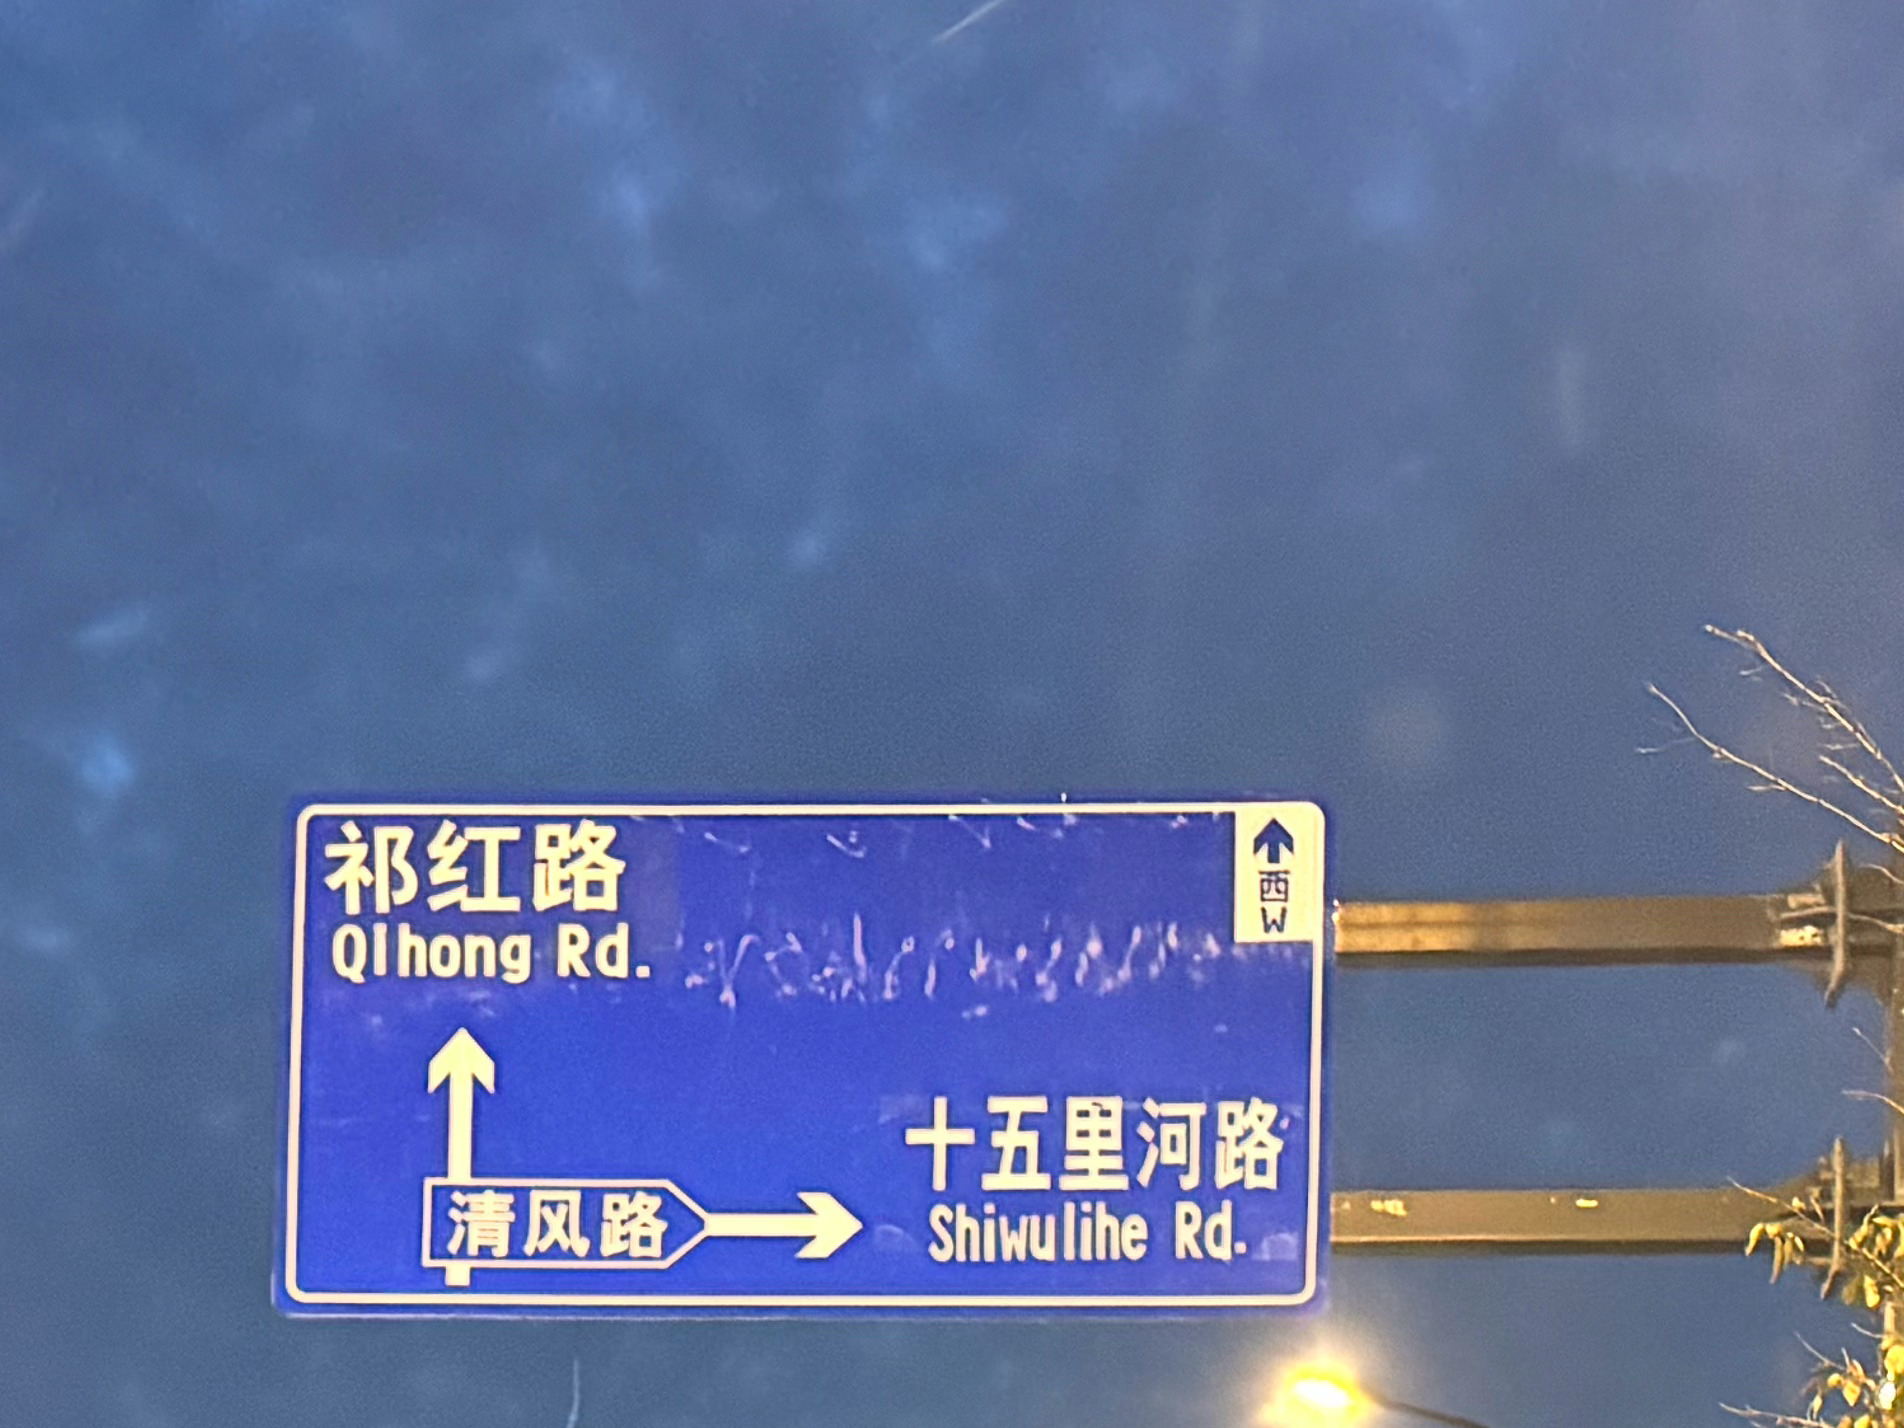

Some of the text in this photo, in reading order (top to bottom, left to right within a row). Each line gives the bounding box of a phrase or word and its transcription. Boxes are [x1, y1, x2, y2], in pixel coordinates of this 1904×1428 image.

[324, 819, 627, 916] 祁红路
[1257, 870, 1292, 904] 西
[1260, 905, 1288, 935] W
[331, 921, 651, 985] Qihong Rd.
[904, 1095, 1285, 1192] 十五里河路
[446, 1188, 669, 1259] 清风路
[927, 1198, 1247, 1263] Shiwulihe Rd.
